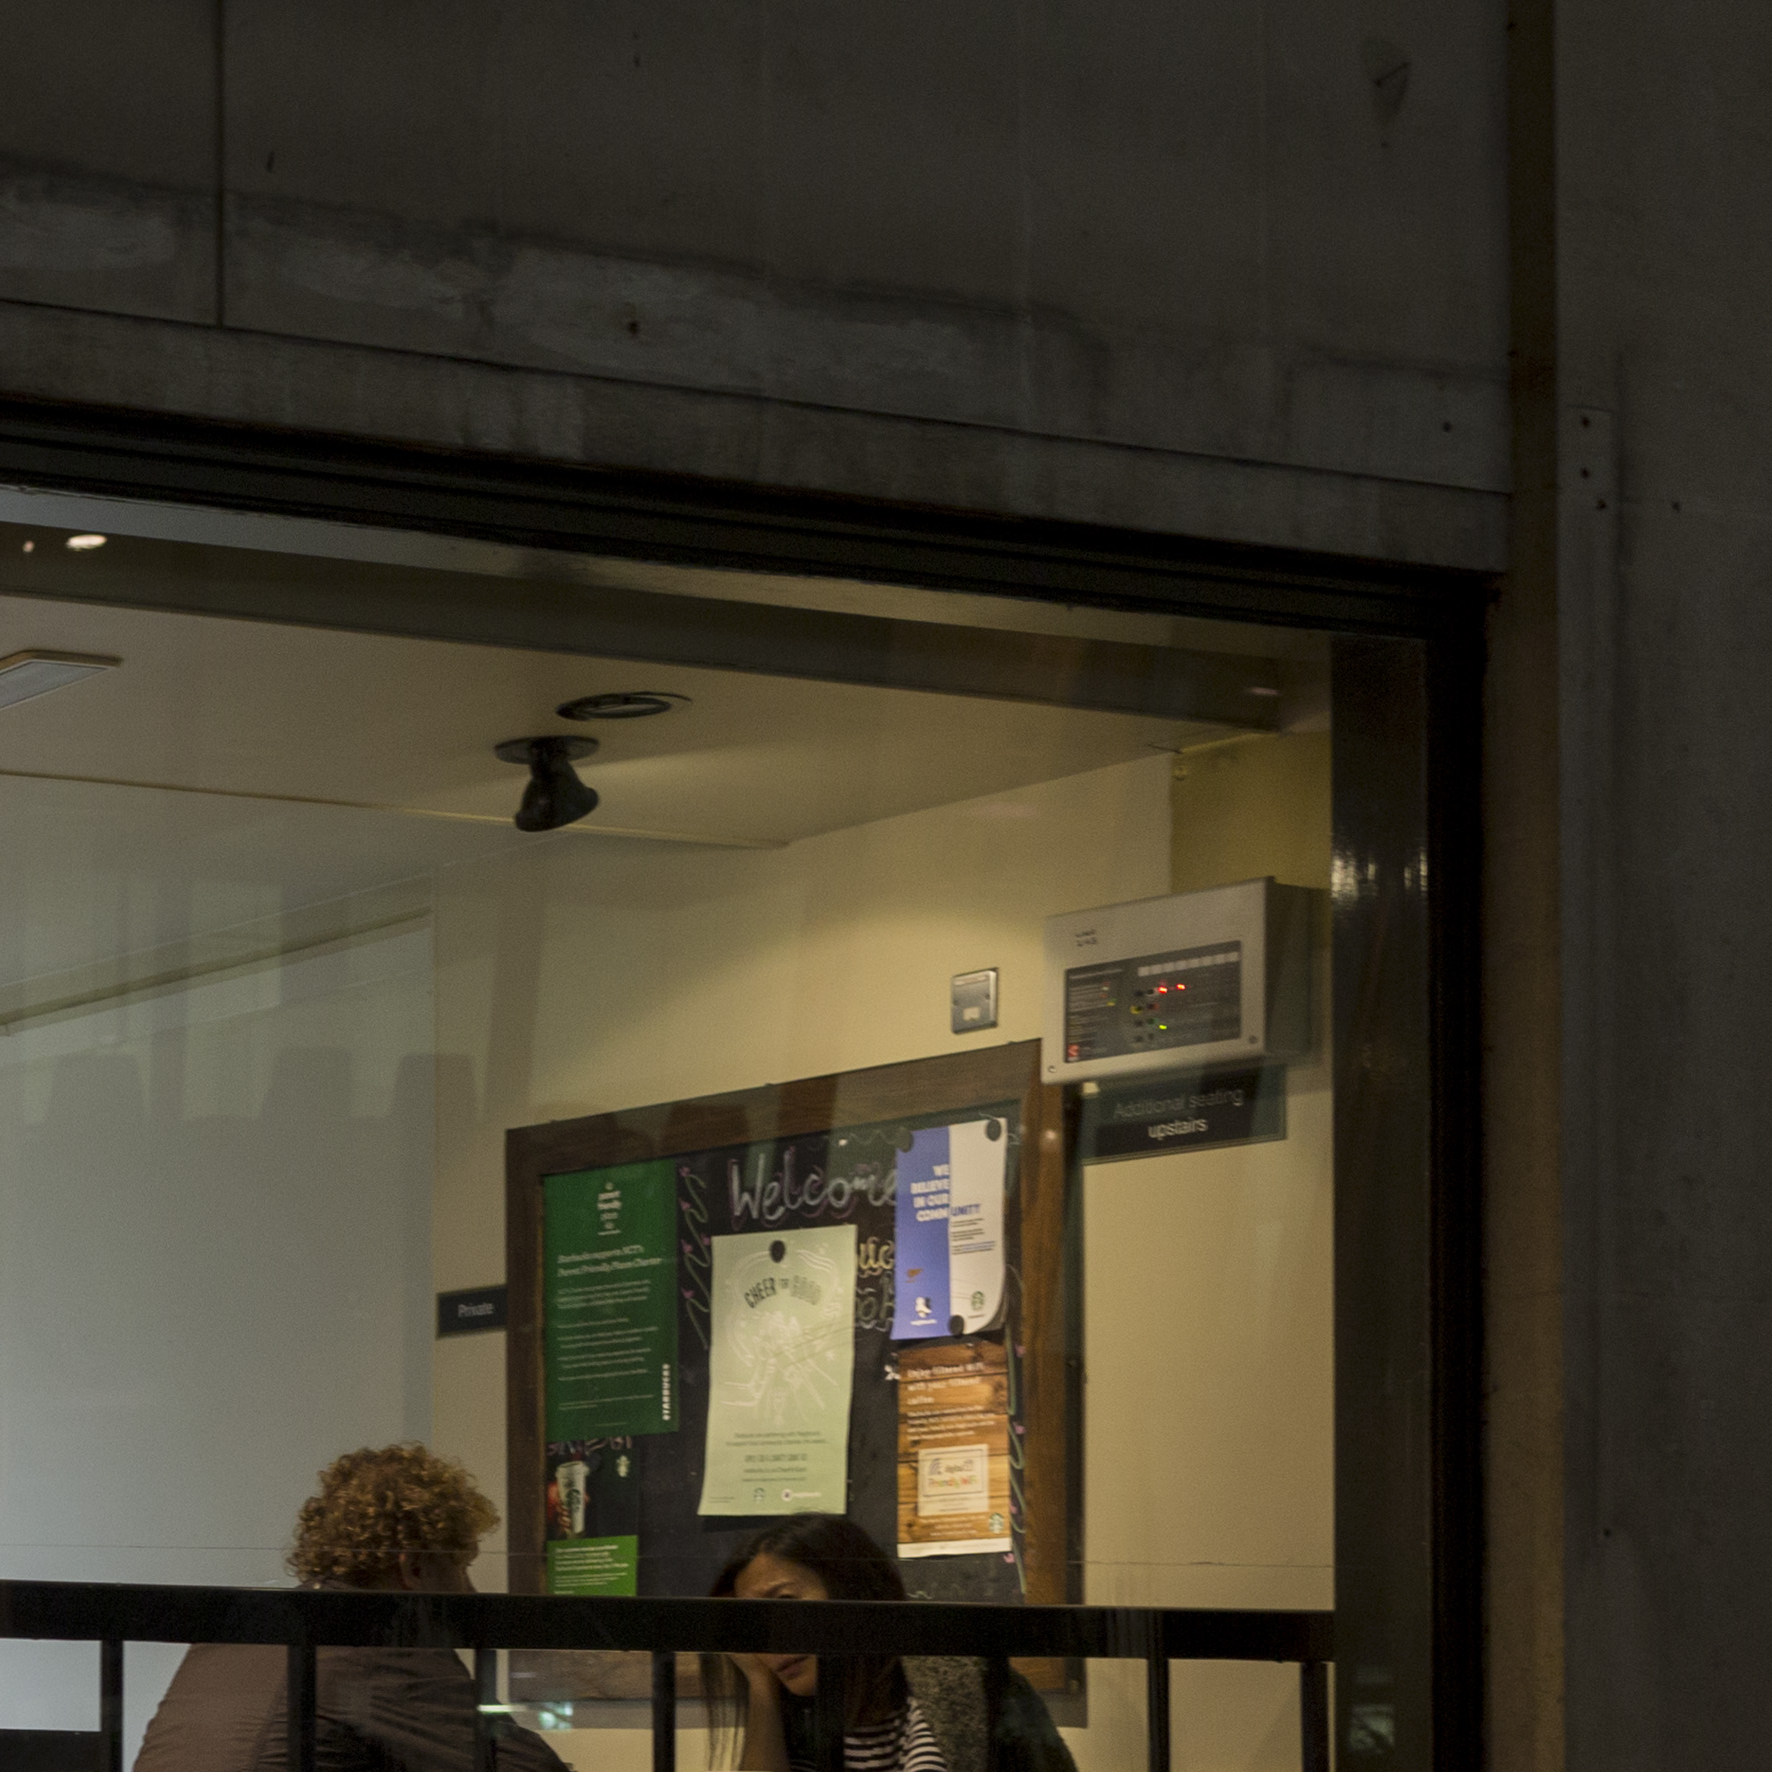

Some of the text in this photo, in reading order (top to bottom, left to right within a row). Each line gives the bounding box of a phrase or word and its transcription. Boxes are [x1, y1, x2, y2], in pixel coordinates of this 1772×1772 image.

[1113, 1088, 1244, 1120] Additional seating
[1147, 1116, 1209, 1141] upstairs
[458, 1302, 494, 1317] Private
[661, 1362, 671, 1422] STARBUCKS
